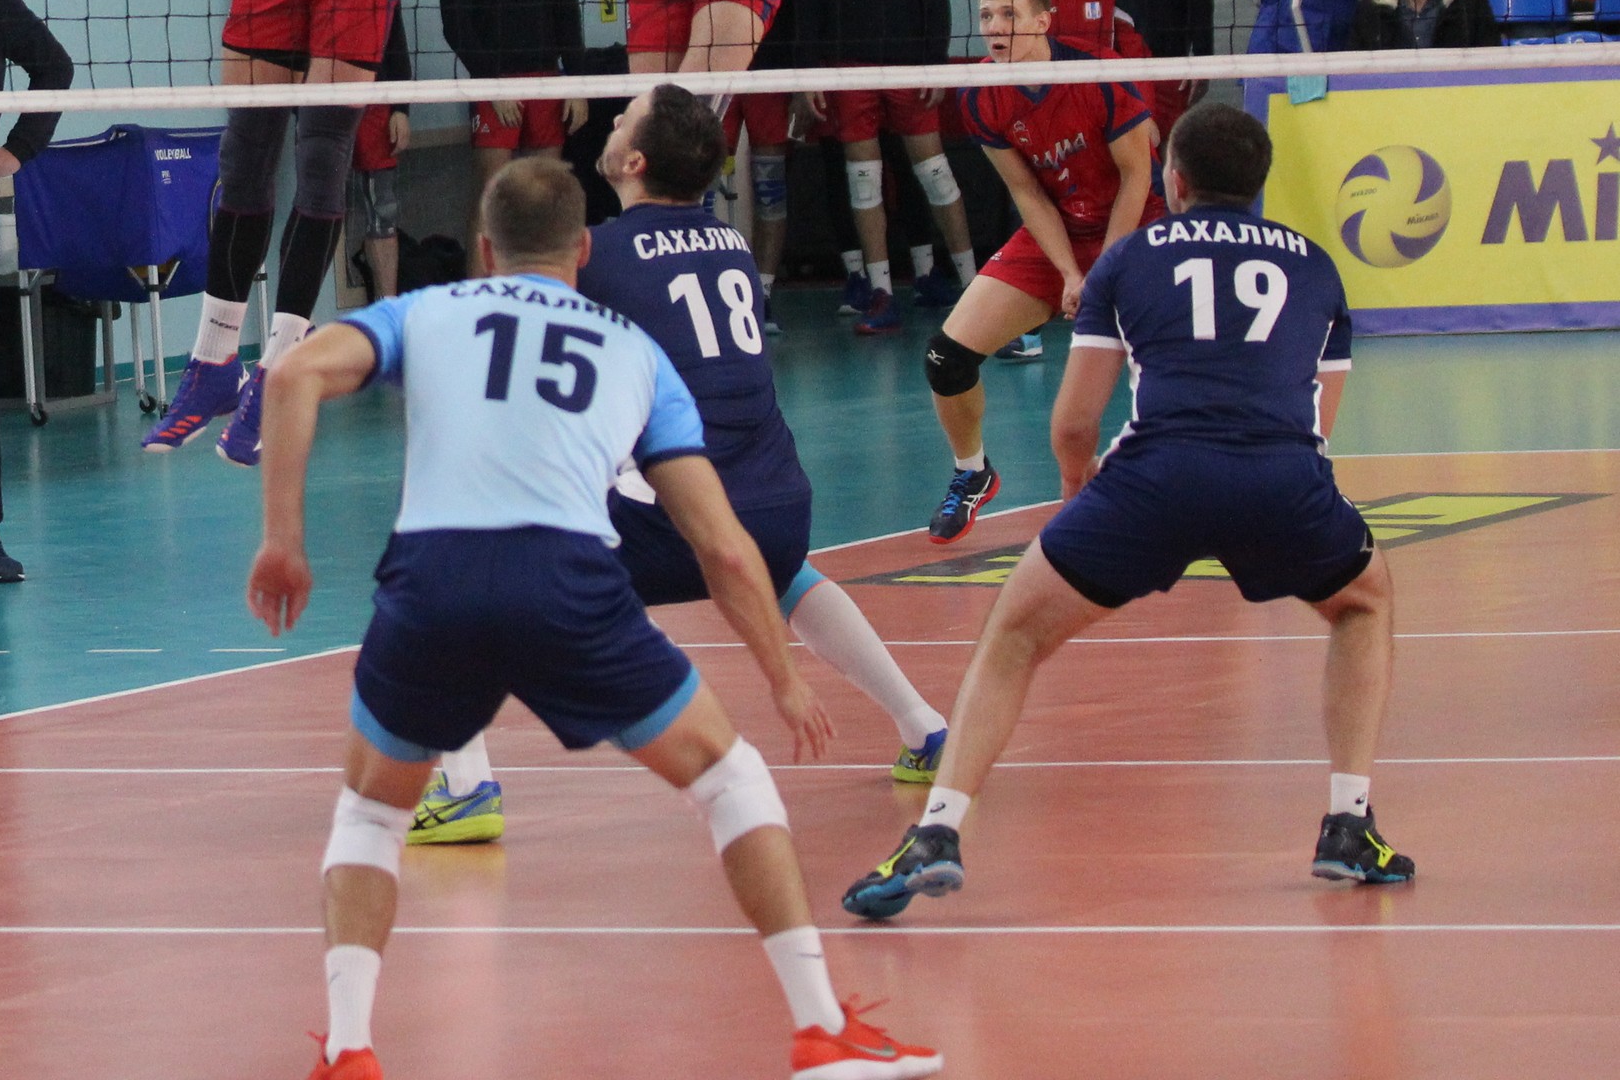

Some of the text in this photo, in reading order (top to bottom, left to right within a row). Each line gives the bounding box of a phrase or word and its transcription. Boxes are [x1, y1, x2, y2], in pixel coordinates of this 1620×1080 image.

[1147, 220, 1309, 257] САХАЛИН
[668, 269, 763, 359] 18
[1174, 257, 1289, 343] 19
[474, 312, 605, 414] 15
